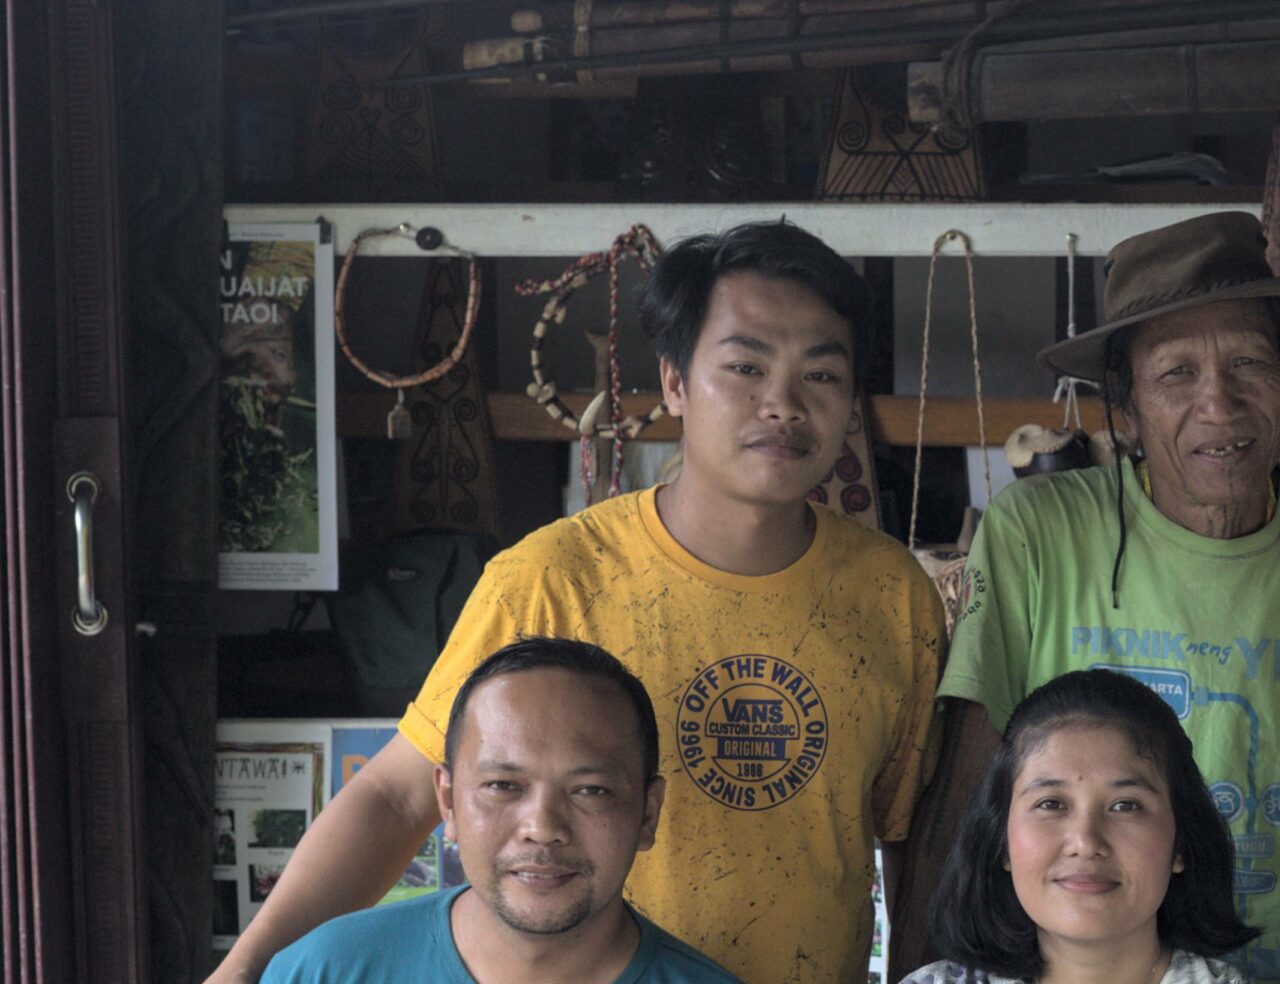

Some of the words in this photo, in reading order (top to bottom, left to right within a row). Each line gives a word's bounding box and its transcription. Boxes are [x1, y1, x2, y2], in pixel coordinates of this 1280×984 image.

[1072, 625, 1188, 661] PIKNIK
[1186, 640, 1232, 665] neng
[721, 658, 767, 681] THE
[1144, 682, 1184, 696] ARTA
[685, 669, 720, 713] OFF
[771, 662, 819, 718] WALL
[709, 722, 750, 735] CUSTOM
[751, 723, 796, 736] CLASSIC
[722, 698, 784, 723] VANS
[680, 720, 706, 768] 1966
[724, 740, 777, 757] ORIGINAL
[762, 720, 825, 803] ORIGINAL
[698, 768, 756, 807] SINCE
